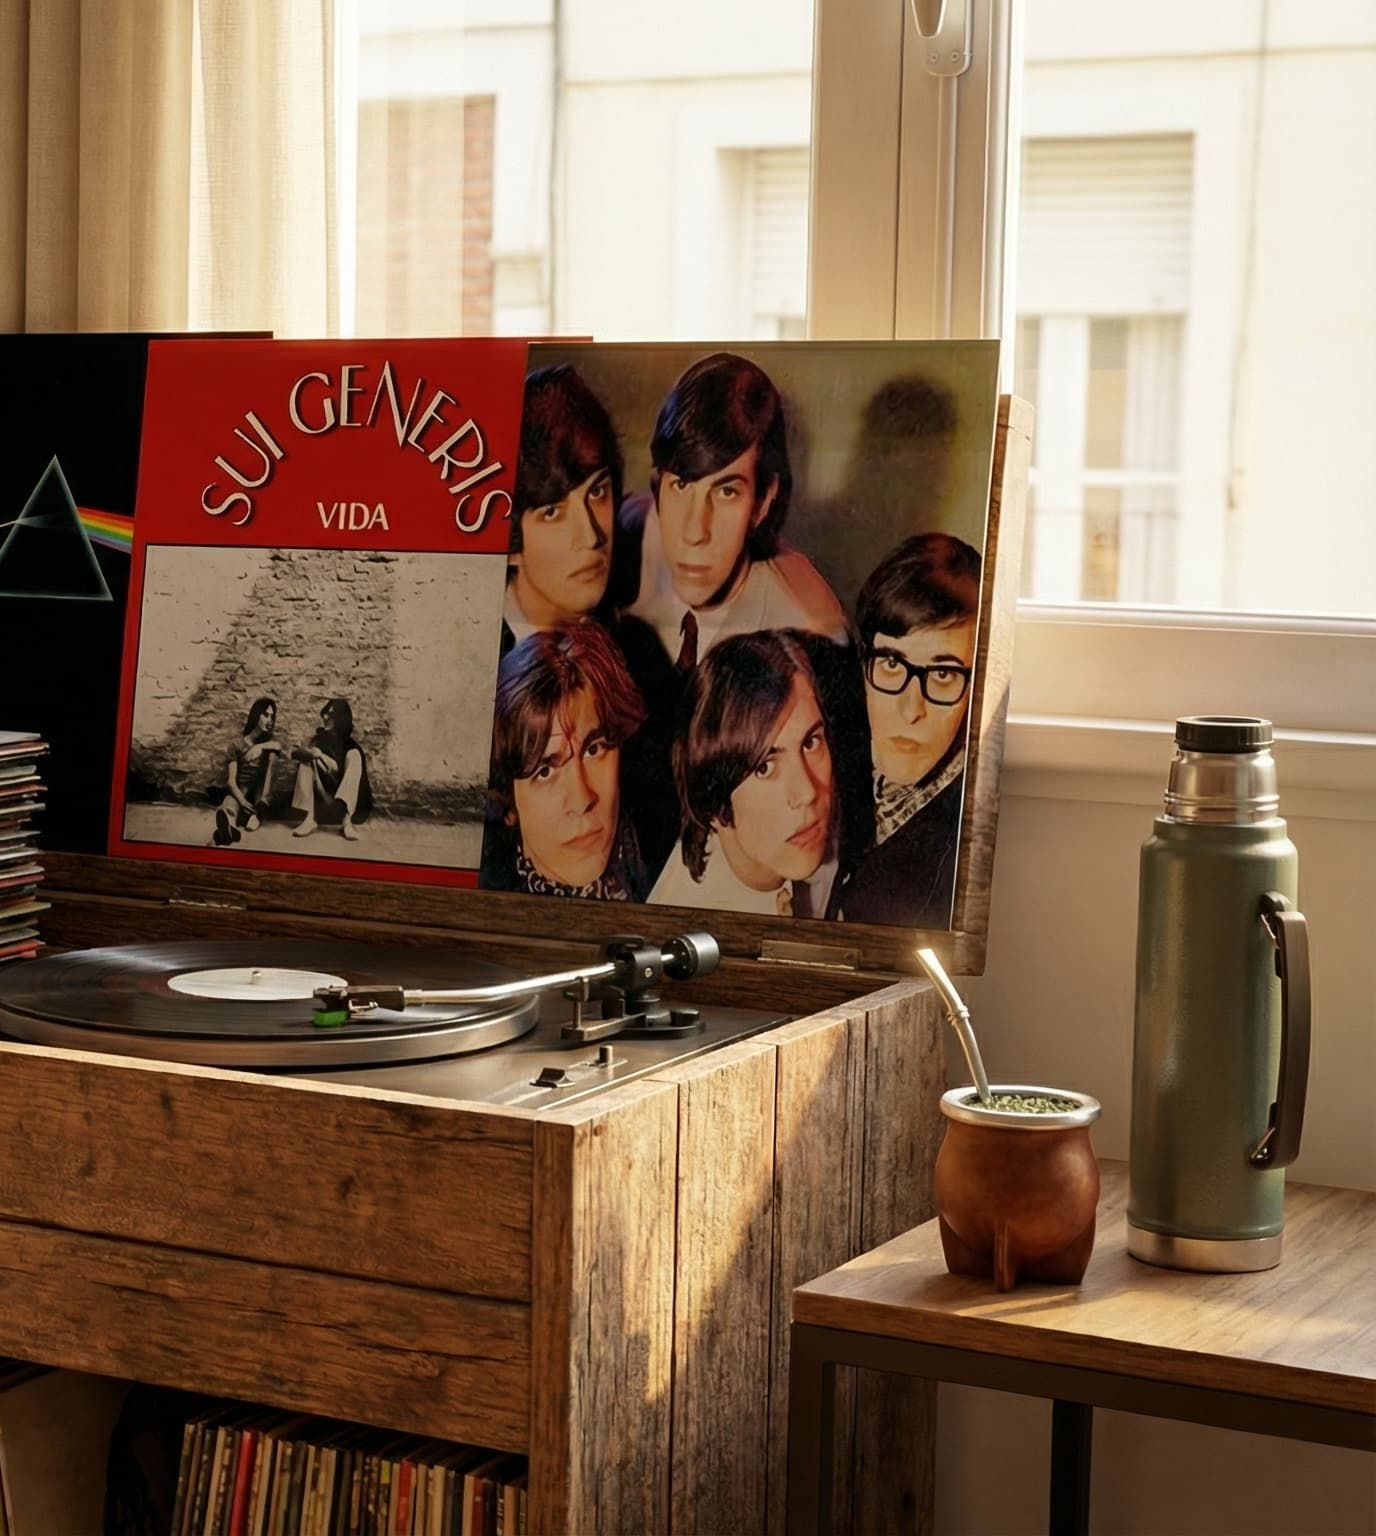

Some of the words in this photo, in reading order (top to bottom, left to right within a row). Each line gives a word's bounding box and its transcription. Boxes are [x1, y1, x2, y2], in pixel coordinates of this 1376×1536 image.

[201, 410, 284, 526] SUI
[289, 360, 513, 533] GENERIS
[317, 502, 389, 530] VIDA
